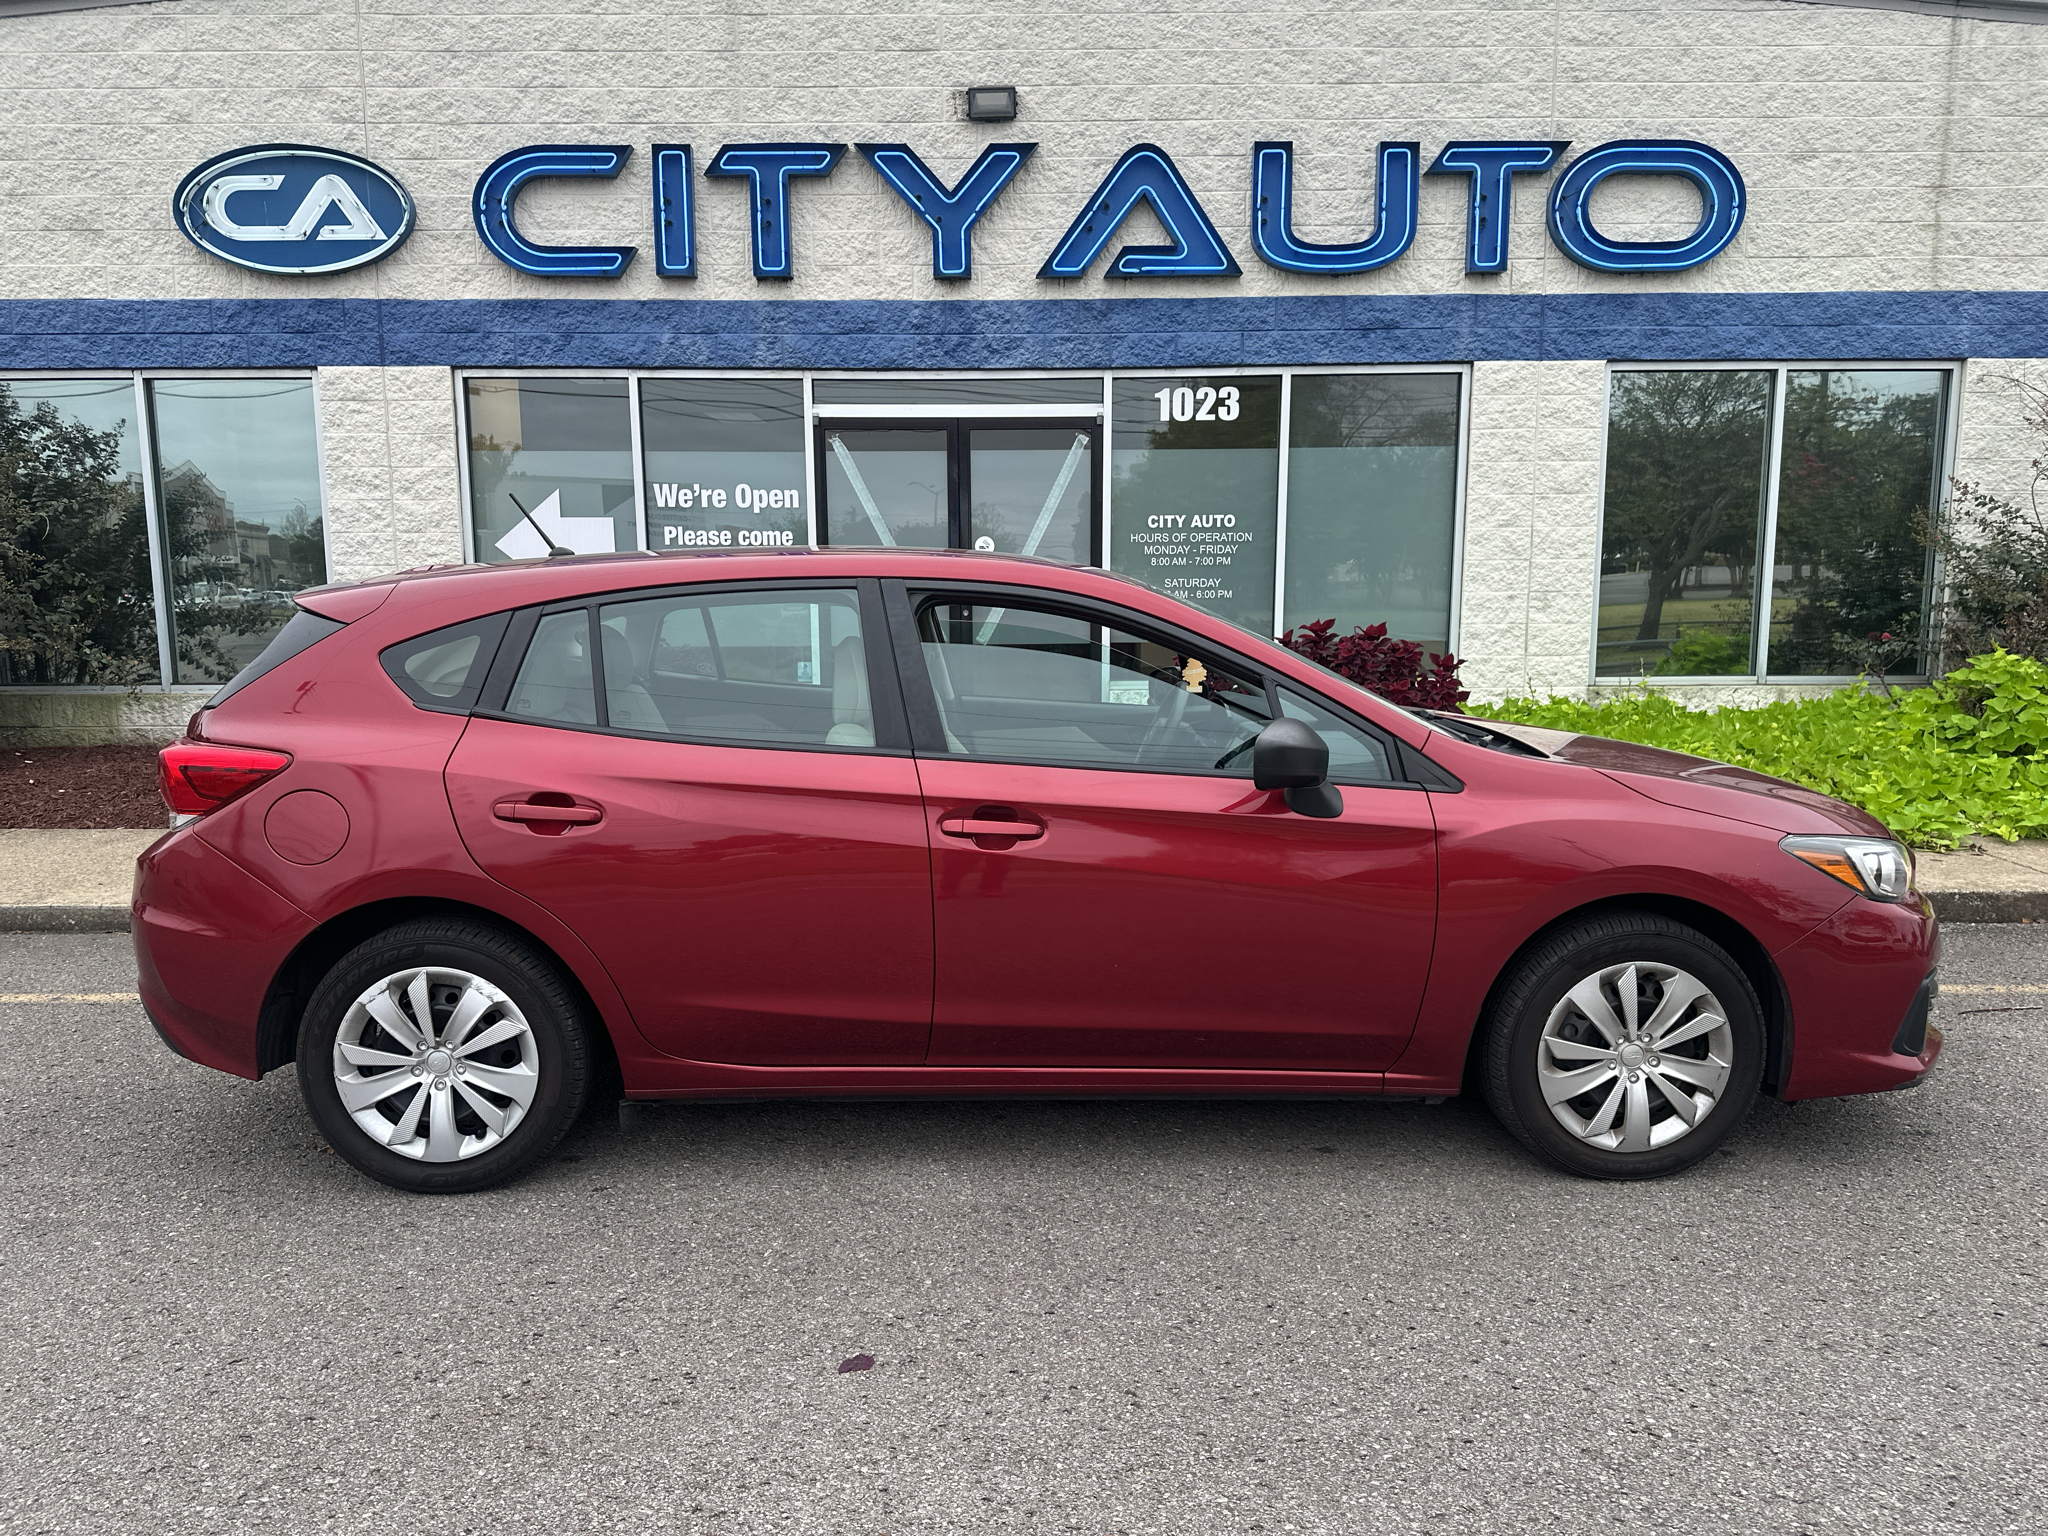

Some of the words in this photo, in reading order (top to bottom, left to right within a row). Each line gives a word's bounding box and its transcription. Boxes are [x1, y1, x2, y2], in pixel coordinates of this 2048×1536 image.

[472, 142, 1039, 281] CITY
[1036, 138, 1747, 278] AUTO
[1154, 386, 1240, 422] 1023
[653, 483, 727, 509] We're
[734, 483, 800, 513] Open
[1147, 515, 1186, 528] CITY
[1190, 514, 1236, 528] AUTO
[664, 525, 732, 546] Please
[738, 529, 794, 546] come
[1130, 533, 1169, 543] HOURS
[1172, 533, 1187, 542] OF
[1189, 532, 1253, 542] OPERATION
[1144, 545, 1191, 555] MONDAY
[1199, 545, 1239, 554] FRIDAY
[1150, 557, 1170, 566] 8:00
[1171, 557, 1187, 566] AM
[1194, 557, 1214, 566] 7:00
[1216, 557, 1231, 565] PM
[1164, 578, 1221, 588] SATURDAY
[1196, 590, 1216, 599] 6:00
[1217, 590, 1233, 598] PM
[316, 945, 417, 1022] STARFIRE
